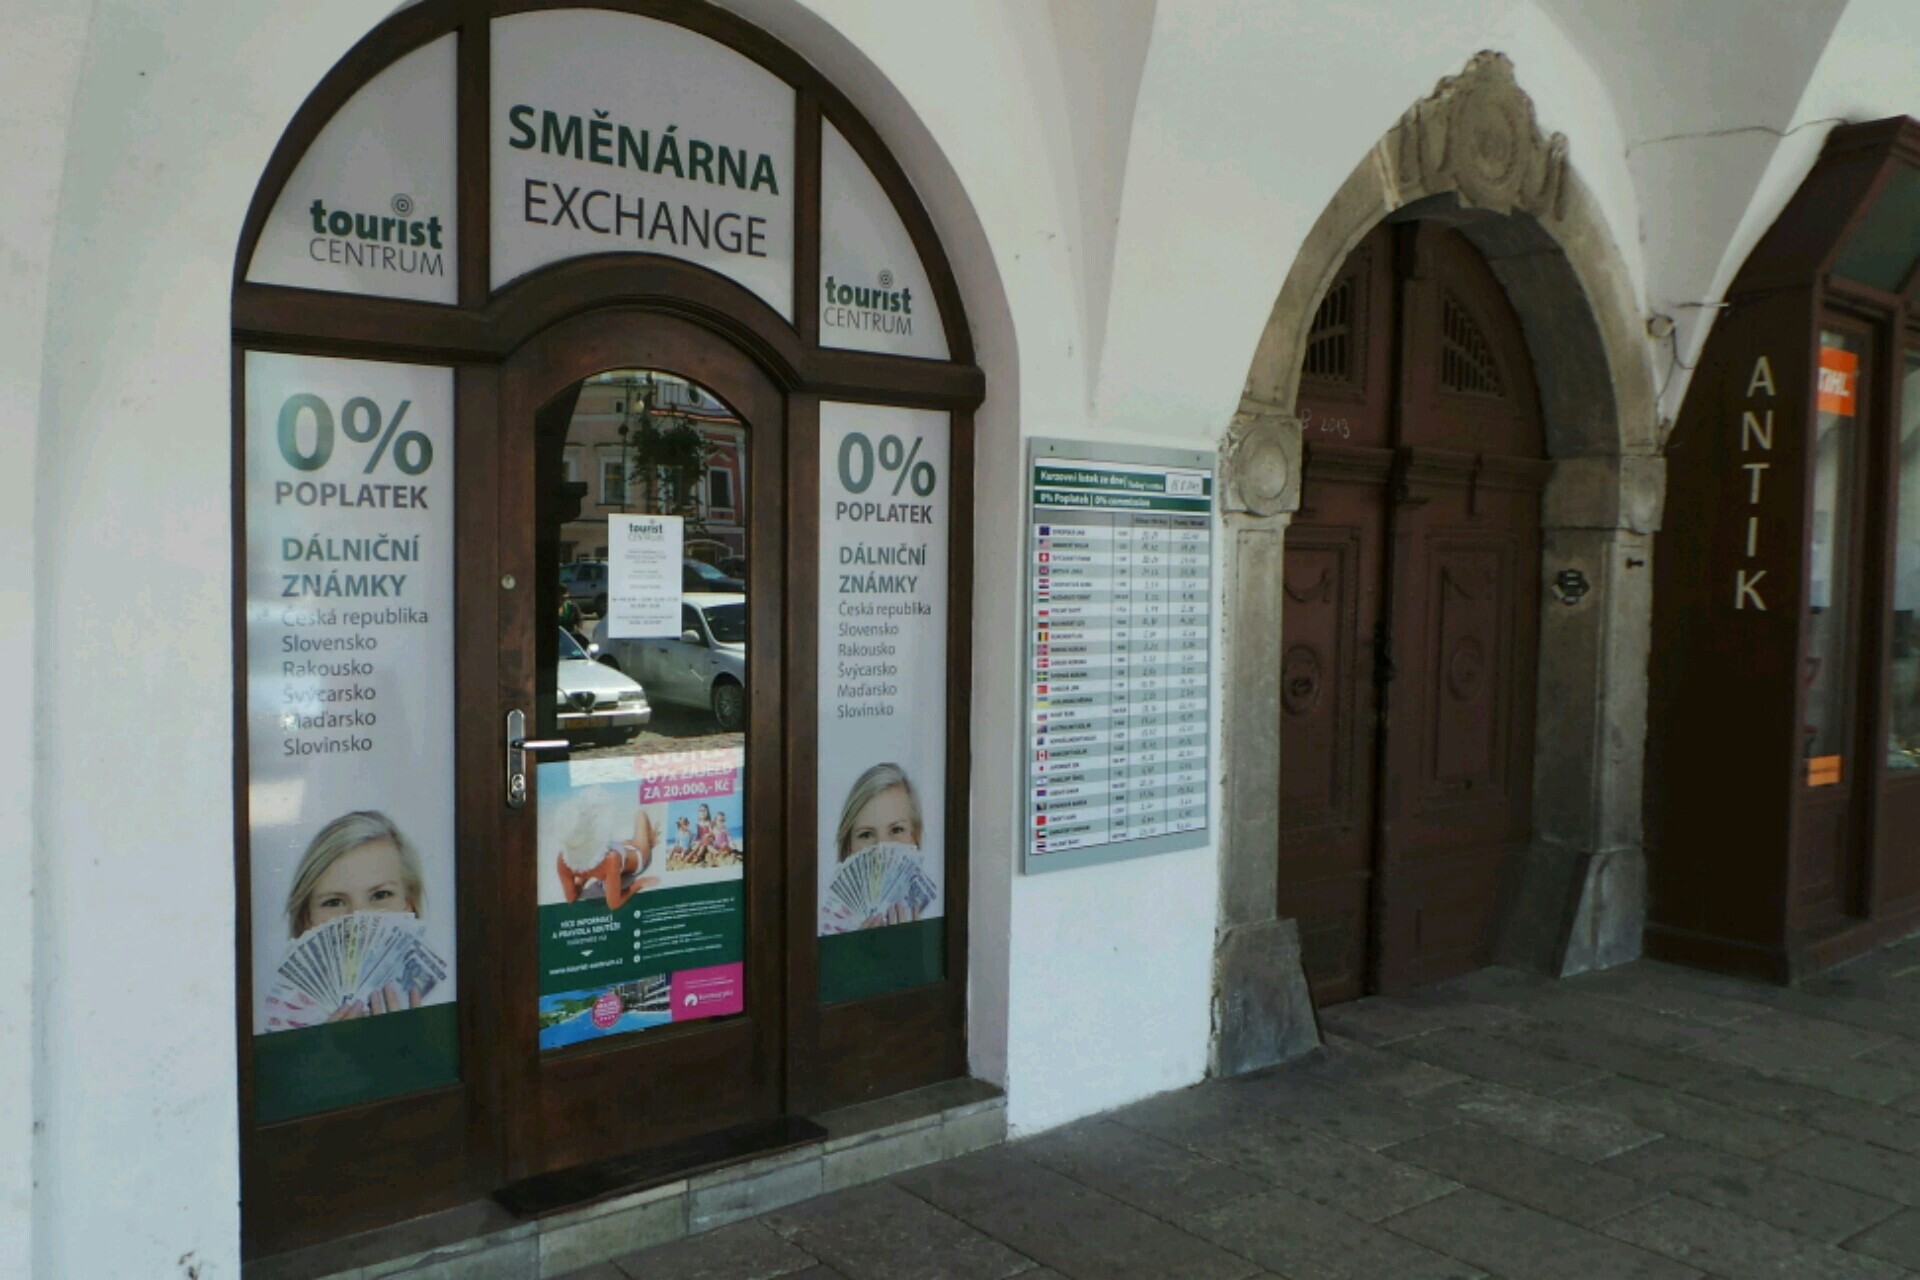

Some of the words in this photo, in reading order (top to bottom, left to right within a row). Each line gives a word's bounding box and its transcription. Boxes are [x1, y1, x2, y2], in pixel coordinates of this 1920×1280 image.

[508, 104, 779, 195] SMĚNÁRNA
[309, 194, 443, 249] tourist
[523, 179, 768, 257] EXCHANGE
[309, 237, 444, 276] CENTRUM
[825, 271, 912, 315] tourist
[824, 306, 912, 335] CENTRUM
[276, 393, 434, 475] 0%
[838, 432, 936, 497] 0%
[1735, 356, 1776, 611] ANTIK
[275, 481, 429, 509] POPLATEK
[836, 501, 933, 523] POPLATEK
[629, 520, 663, 534] tourist
[281, 533, 420, 562] DÁLNIČNÍ
[839, 542, 927, 566] DÁLNIČNÍ
[281, 570, 407, 598] ZNÁMKY
[839, 571, 918, 593] ZNÁMKY
[282, 606, 337, 627] Česká
[343, 607, 429, 628] republika
[838, 600, 874, 617] Česká
[876, 601, 931, 619] republika
[838, 621, 899, 637] Slovensko
[282, 633, 378, 652] Slovensko
[838, 641, 896, 656] Rakousko
[283, 659, 374, 677] Rakousko
[838, 660, 897, 680] Švýcarsko
[838, 682, 898, 698] Maďarsko
[837, 703, 895, 719] Slovinsko
[284, 735, 372, 757] Slovinsko
[643, 786, 661, 799] ZA
[715, 779, 730, 792] Kč
